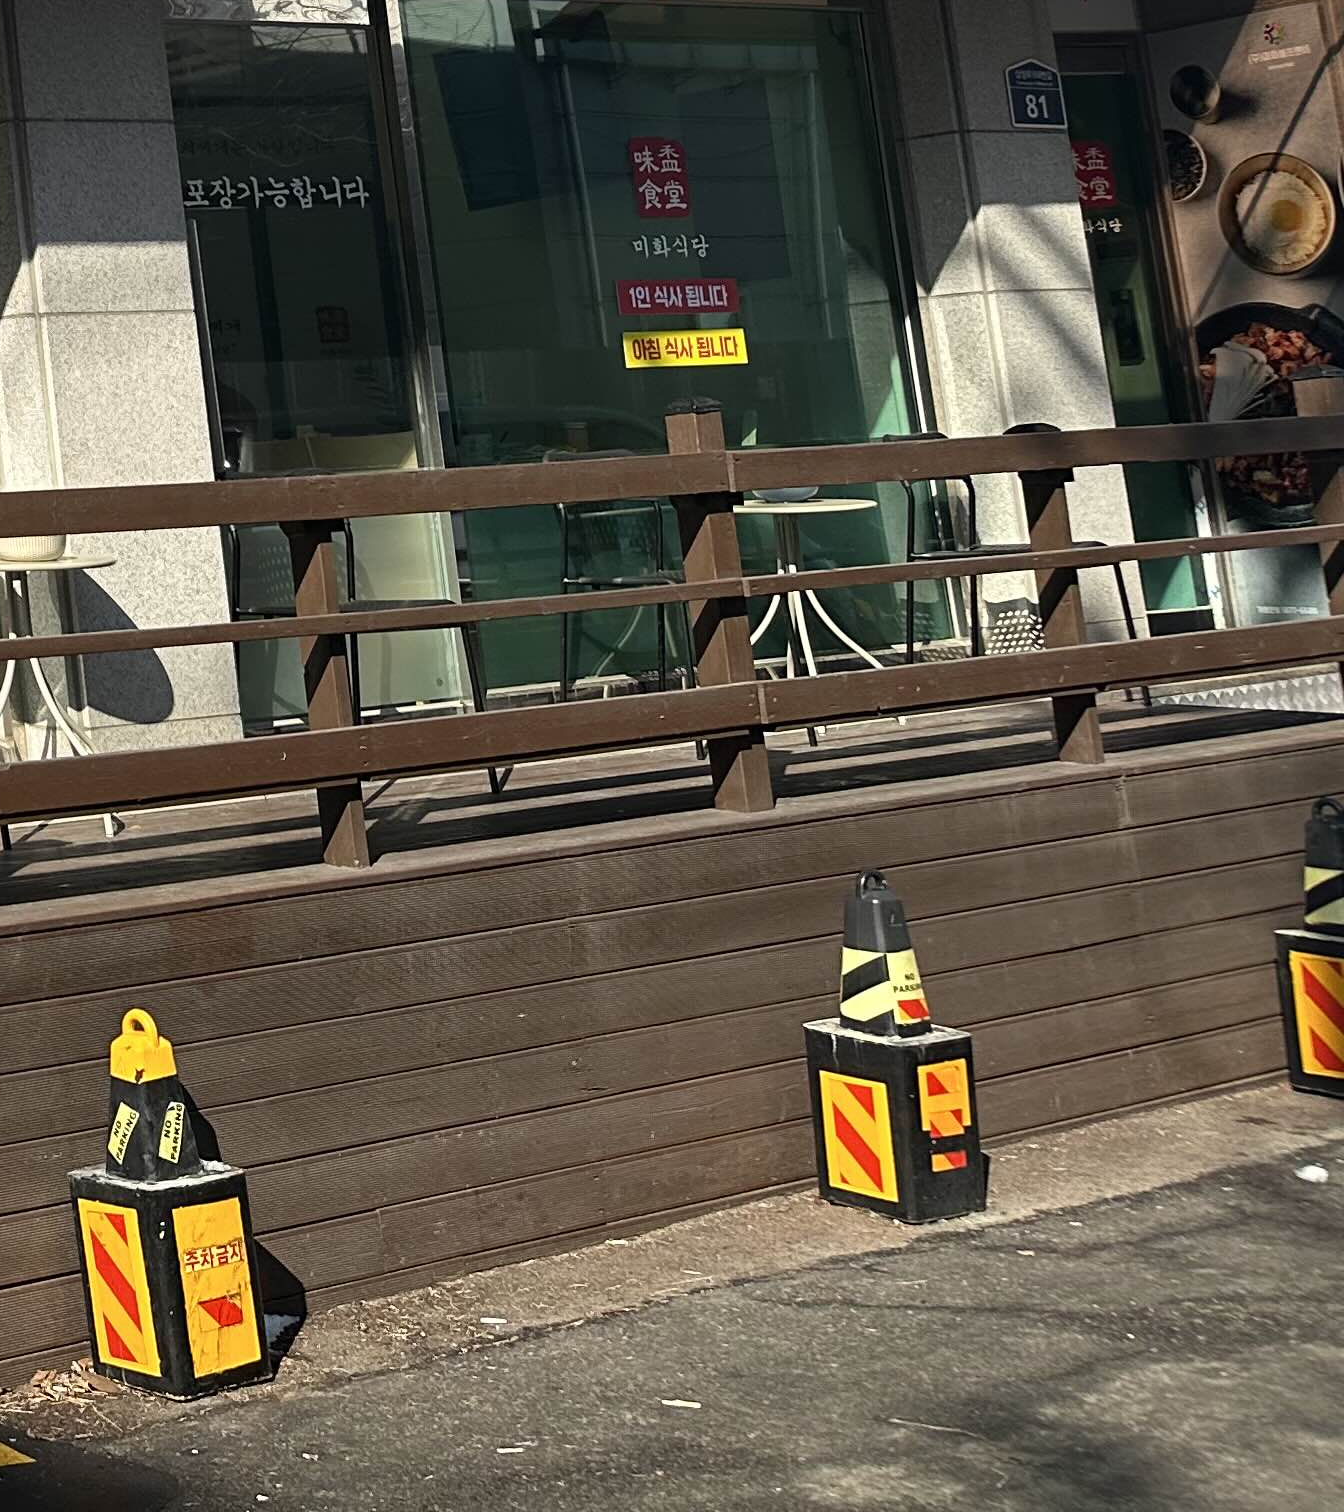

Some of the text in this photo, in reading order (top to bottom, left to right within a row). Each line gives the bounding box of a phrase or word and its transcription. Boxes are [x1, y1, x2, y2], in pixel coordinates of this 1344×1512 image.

[1025, 93, 1049, 119] 81
[183, 175, 370, 209] 포장가능합니다
[632, 233, 710, 259] 미화식당
[628, 284, 728, 309] 1인 식사 됩니다
[632, 335, 738, 361] 아침 식사 됩니다
[113, 1120, 122, 1138] NO
[116, 1111, 138, 1161] PARKING
[163, 1119, 172, 1139] NO
[170, 1103, 184, 1161] PARKING
[184, 1238, 245, 1273] 주차금지
